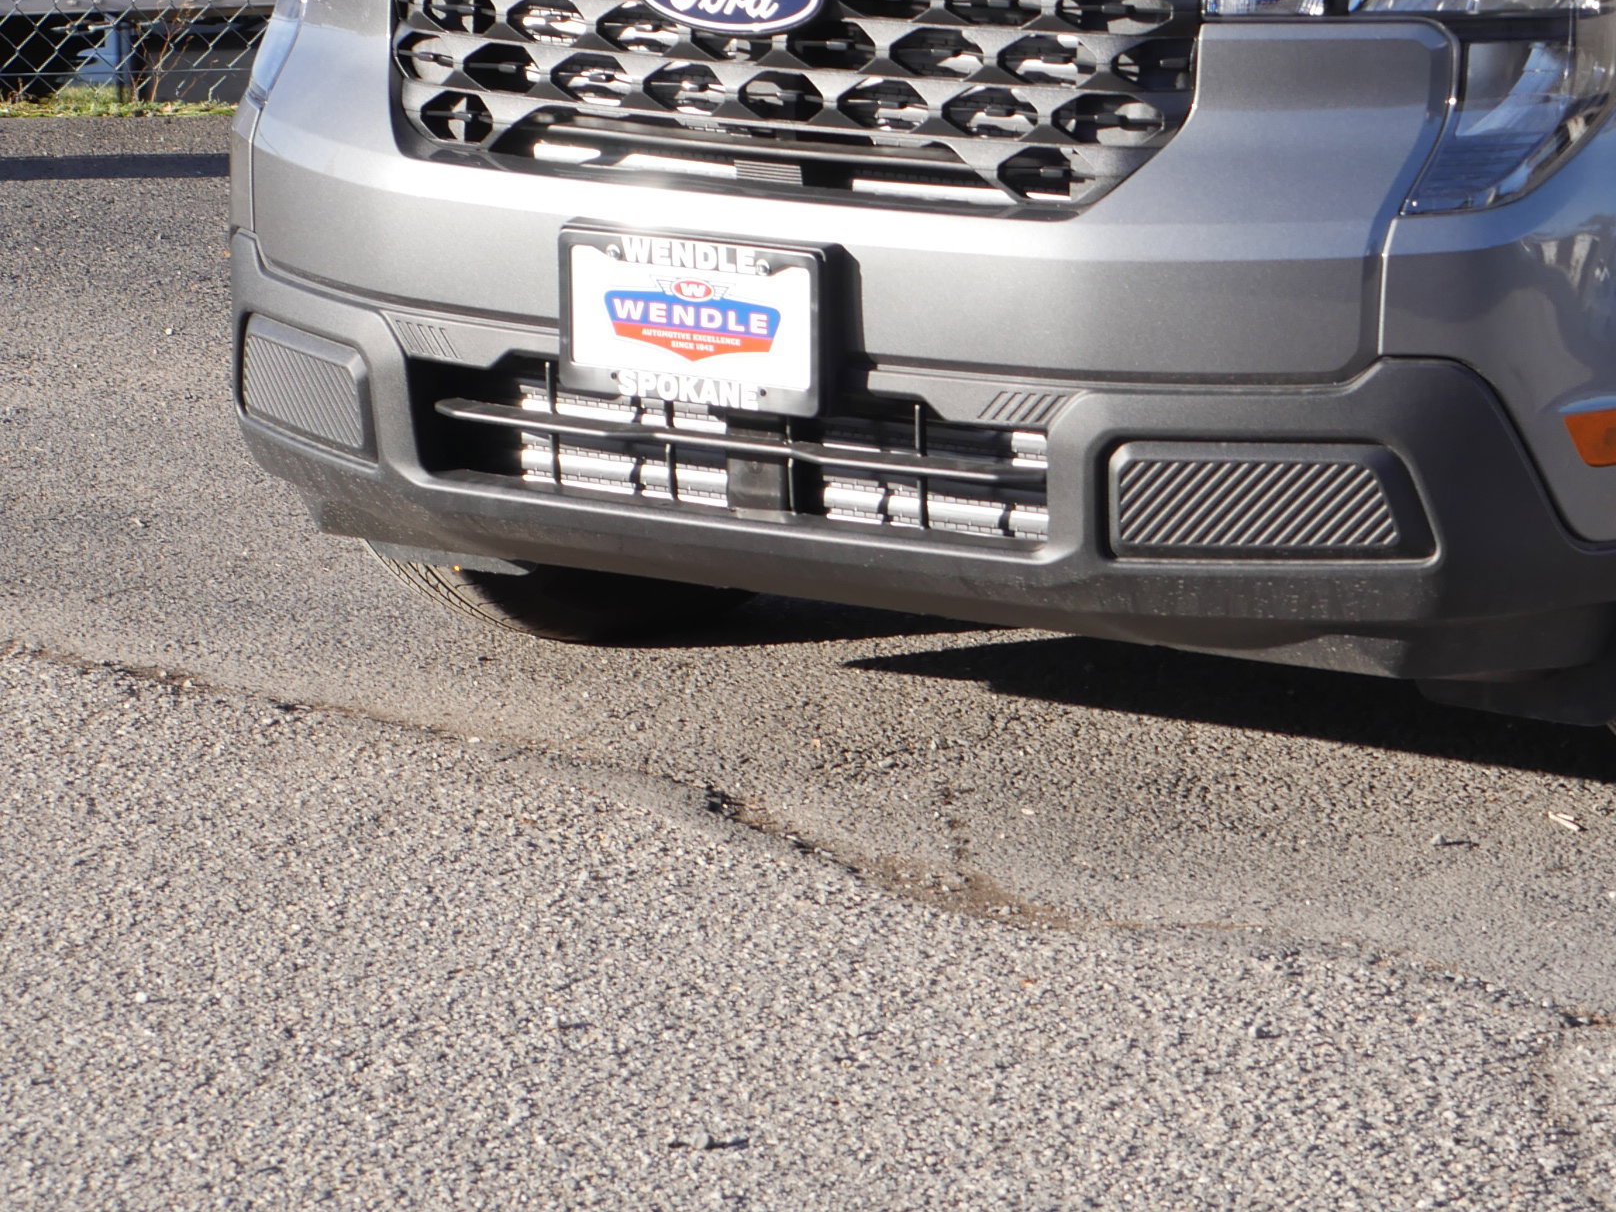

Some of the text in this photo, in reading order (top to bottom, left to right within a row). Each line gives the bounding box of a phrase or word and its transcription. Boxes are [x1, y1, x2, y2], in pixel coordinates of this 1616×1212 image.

[620, 236, 757, 275] WENDLE
[612, 297, 769, 335] WENDLE
[641, 328, 742, 346] AUTOMOTIVE EXCELLENCE
[616, 369, 759, 412] SPOKANE
